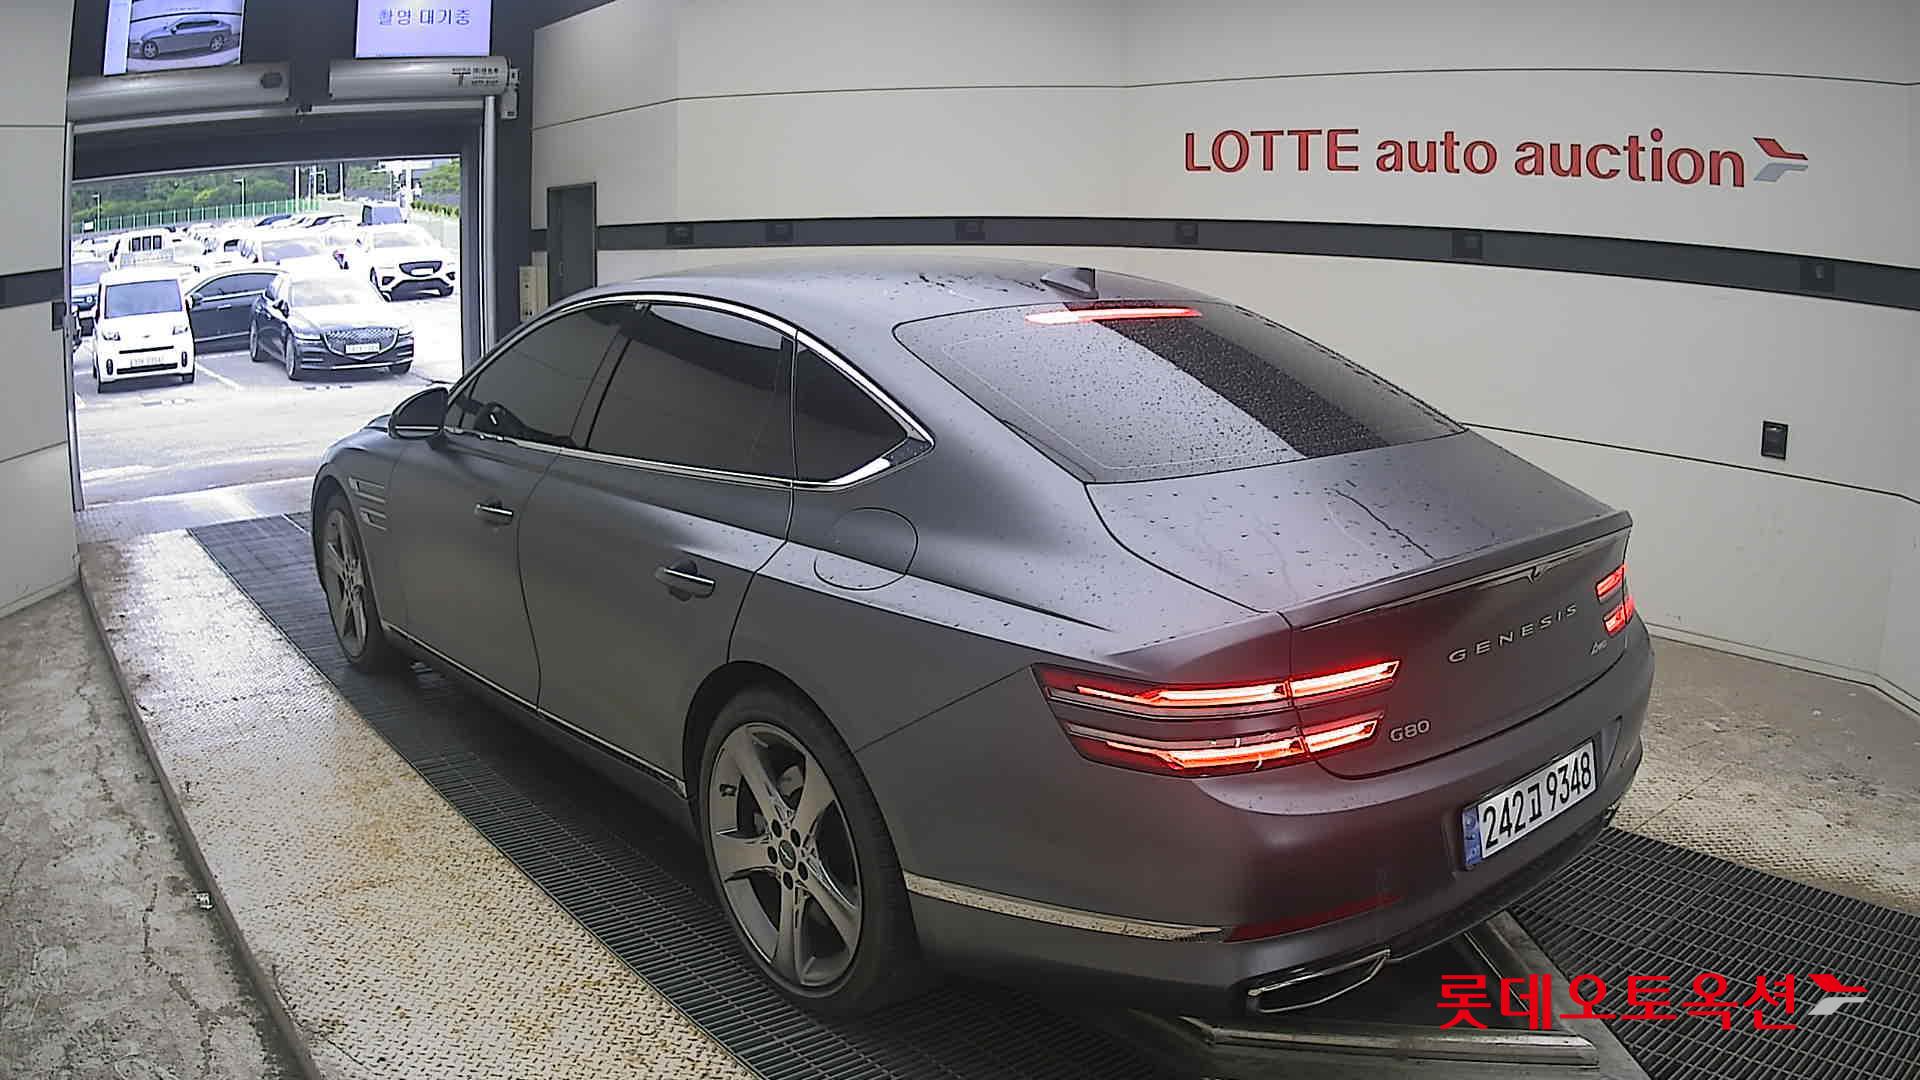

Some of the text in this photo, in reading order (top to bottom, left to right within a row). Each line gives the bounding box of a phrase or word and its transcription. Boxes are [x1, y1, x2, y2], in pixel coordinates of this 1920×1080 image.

[419, 9, 471, 26] 대기중
[1184, 127, 1745, 188] LOTTE auto auction
[1448, 604, 1577, 663] GENESIS
[1389, 719, 1431, 743] G80
